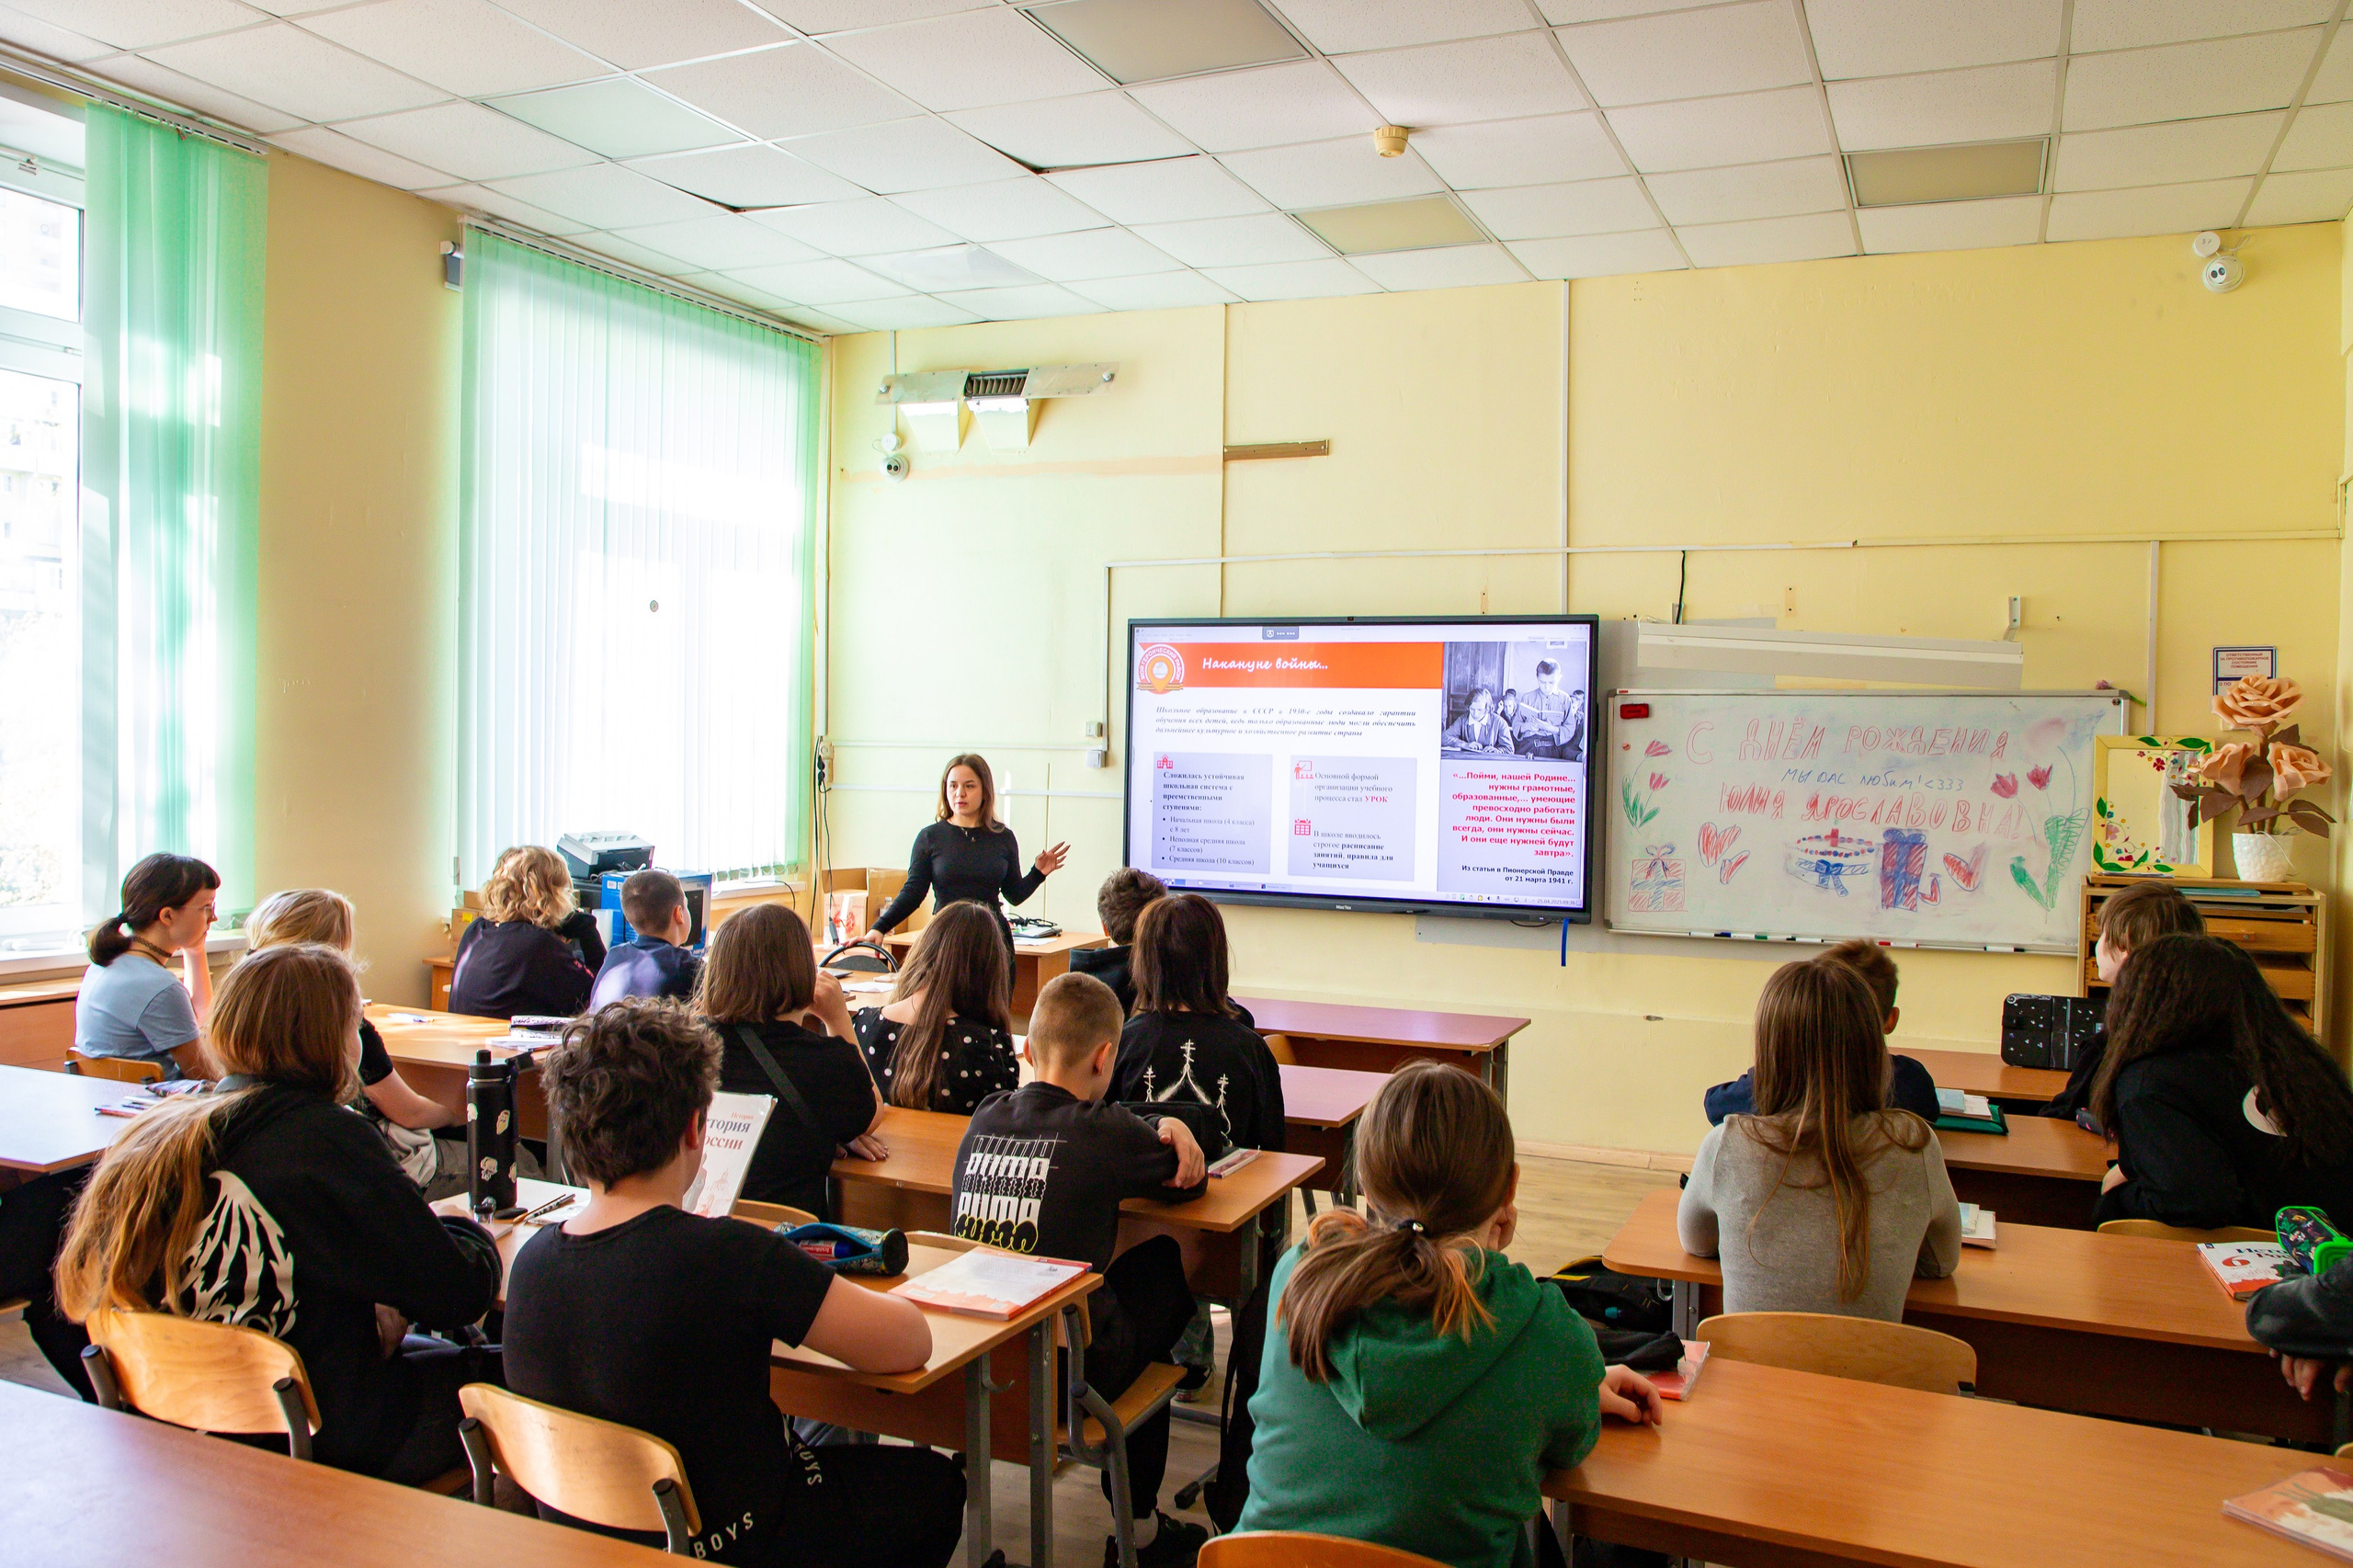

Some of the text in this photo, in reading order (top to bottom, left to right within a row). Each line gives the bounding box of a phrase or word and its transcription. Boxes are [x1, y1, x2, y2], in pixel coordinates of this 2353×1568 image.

[1202, 657, 1328, 673] Накануне войны...
[1155, 717, 1187, 725] обучения
[1204, 717, 1228, 725] детей,
[1155, 726, 1196, 734] дальнейшее
[1686, 716, 2009, 765] С ДНЁМ РОЖДЕНИЯ
[1452, 771, 1576, 783] «...Пойми, нашей Родине...
[1522, 785, 1575, 794] грамотные,
[1364, 795, 1388, 803] УРОК
[1452, 792, 1575, 804] образованные,... умеющие
[1472, 805, 1575, 814] превосходно работать
[1719, 781, 2024, 840] ЮЛИЯ ЯРОСЛАВОВНА!
[1465, 814, 1575, 825] люди. Они нужны были
[1452, 825, 1485, 834] всегда,
[1506, 827, 1539, 835] нужны
[1540, 827, 1574, 836] сейчас.
[1489, 836, 1508, 845] еще
[1510, 837, 1546, 846] нужней
[1548, 838, 1574, 847] будут
[1313, 851, 1346, 860] занятий,
[1533, 849, 1574, 858] завтра».
[1169, 855, 1195, 864] Средняя
[1502, 867, 1546, 875] Пионерской
[1547, 869, 1574, 877] Правде
[731, 1112, 755, 1120] История
[706, 1118, 752, 1134] тория
[705, 1135, 744, 1150] оссии
[2222, 1255, 2250, 1267] 6
[693, 1511, 754, 1560] BOYS
